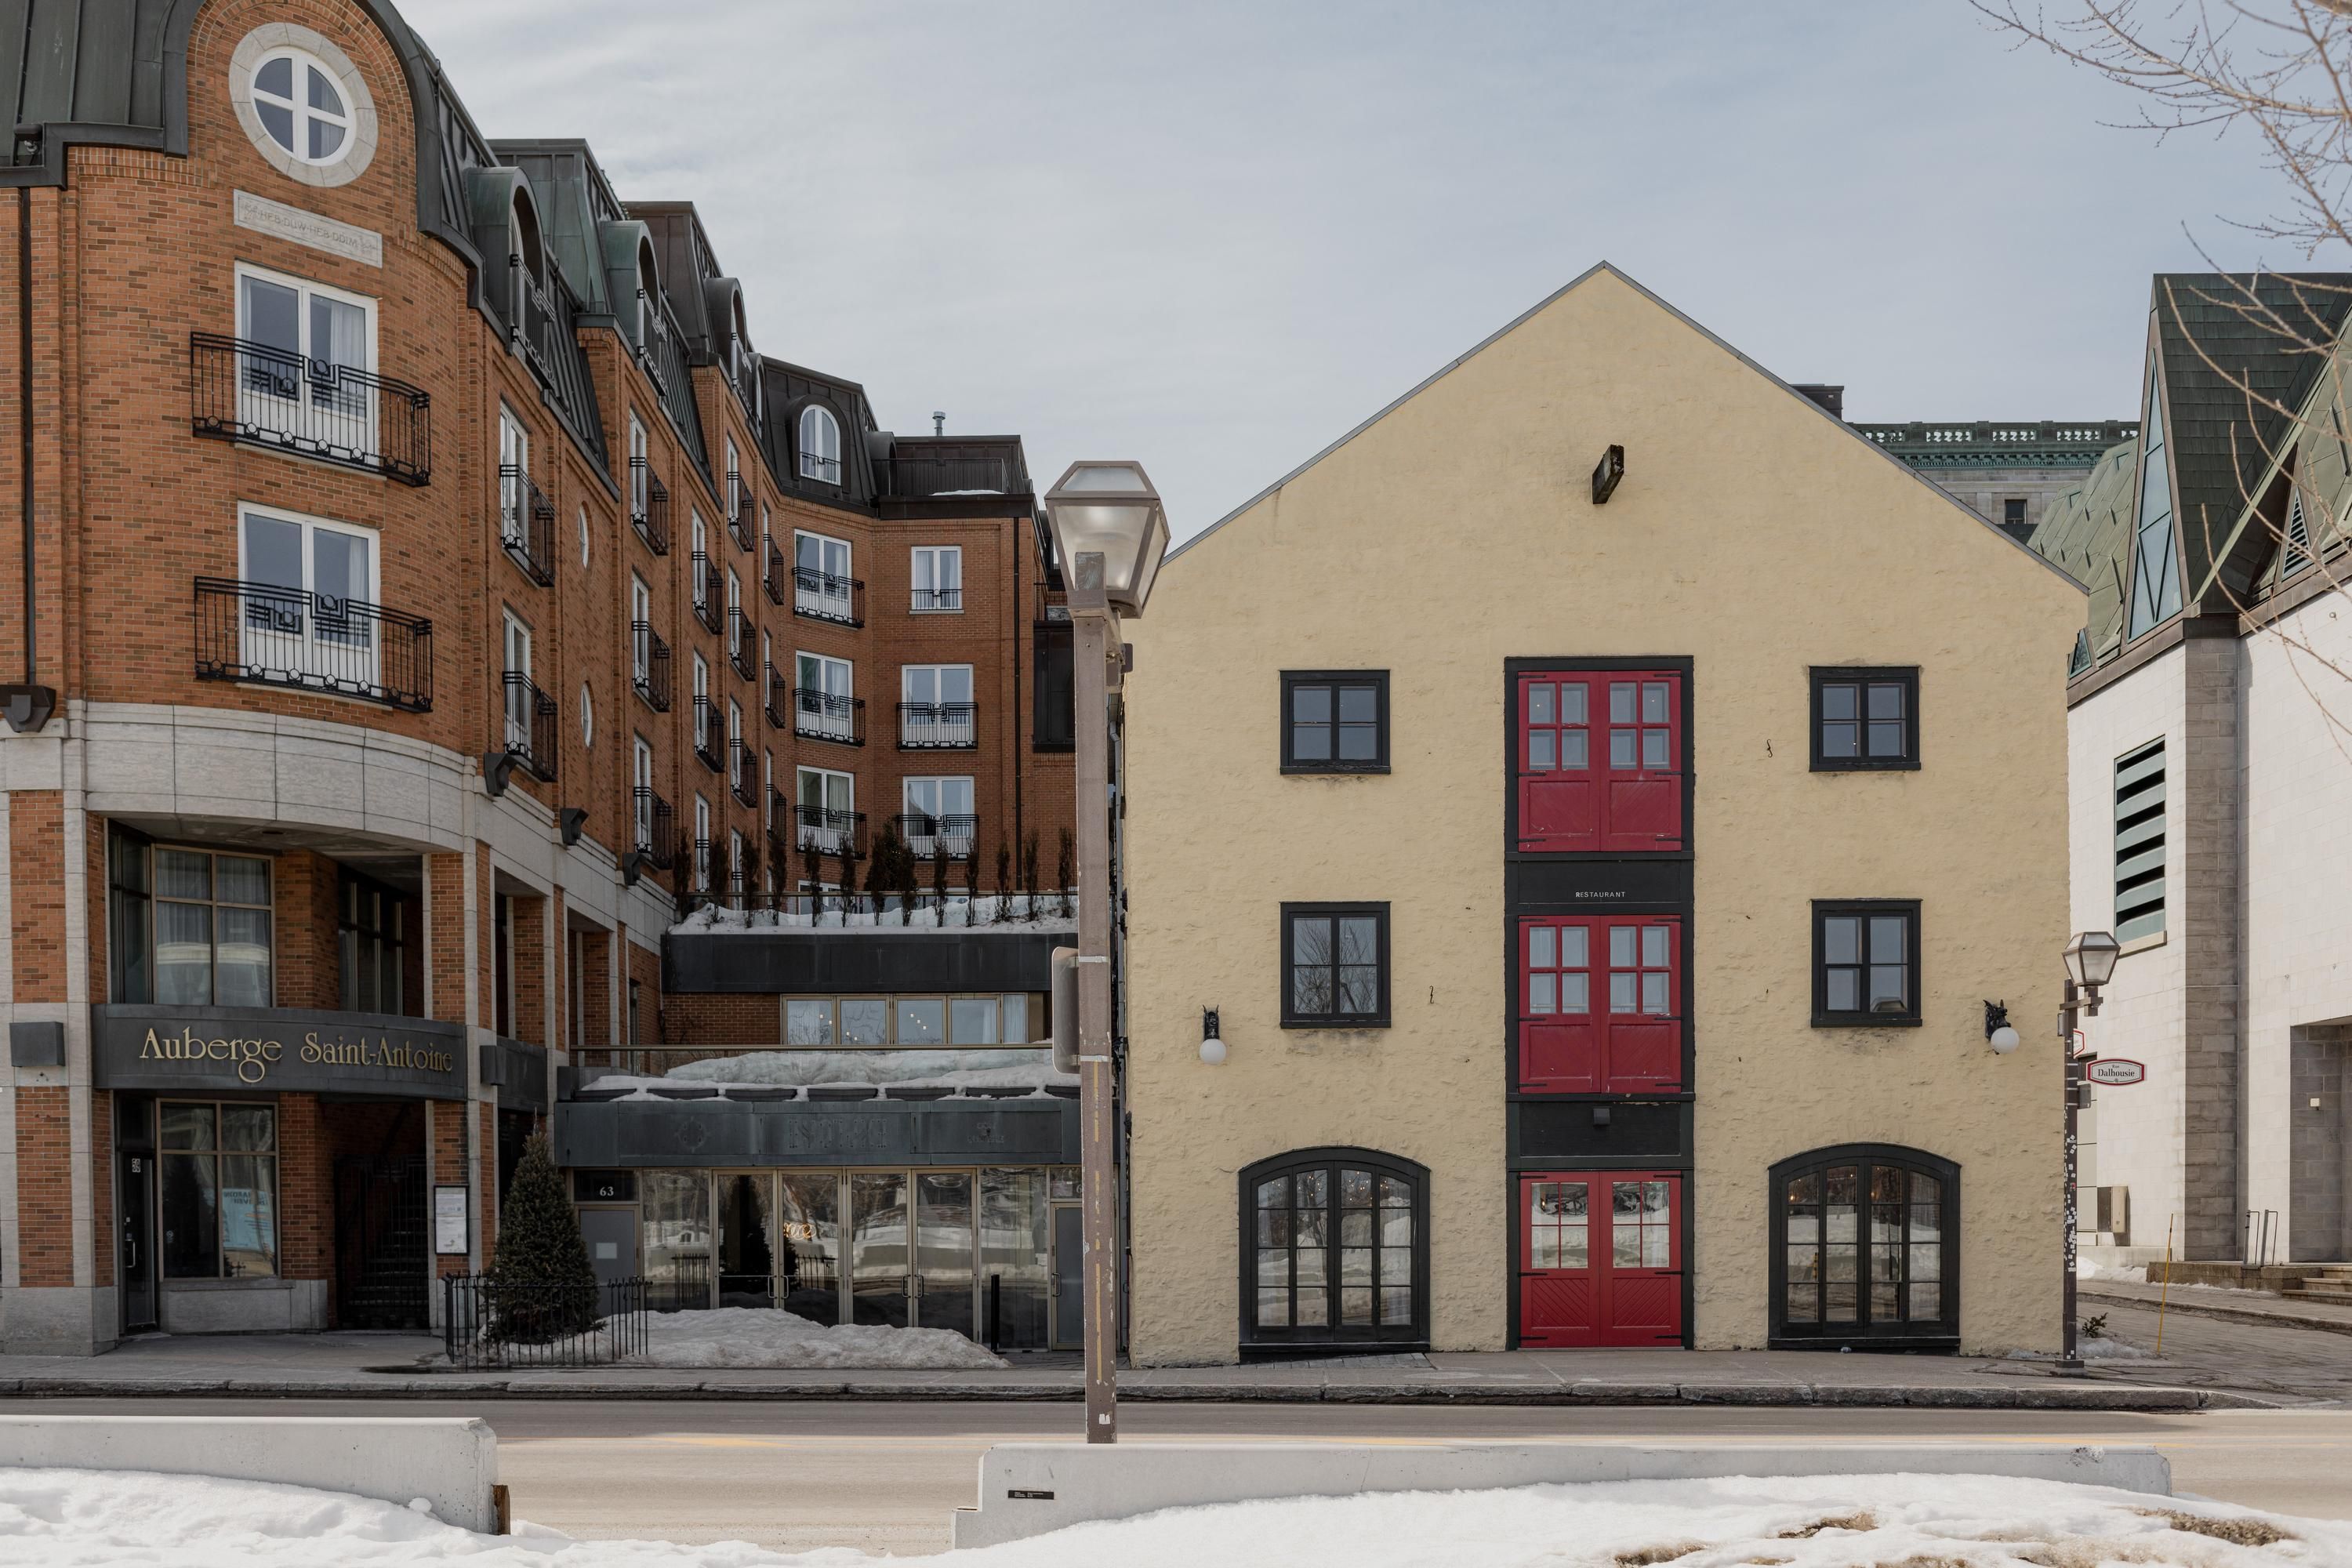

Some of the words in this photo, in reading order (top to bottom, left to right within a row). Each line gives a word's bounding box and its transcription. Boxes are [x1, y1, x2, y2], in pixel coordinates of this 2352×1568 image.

[139, 1026, 282, 1083] Auberge
[300, 1032, 452, 1072] Saint-Antoine
[2097, 1068, 2135, 1077] Dalhousie
[599, 1186, 614, 1196] 63
